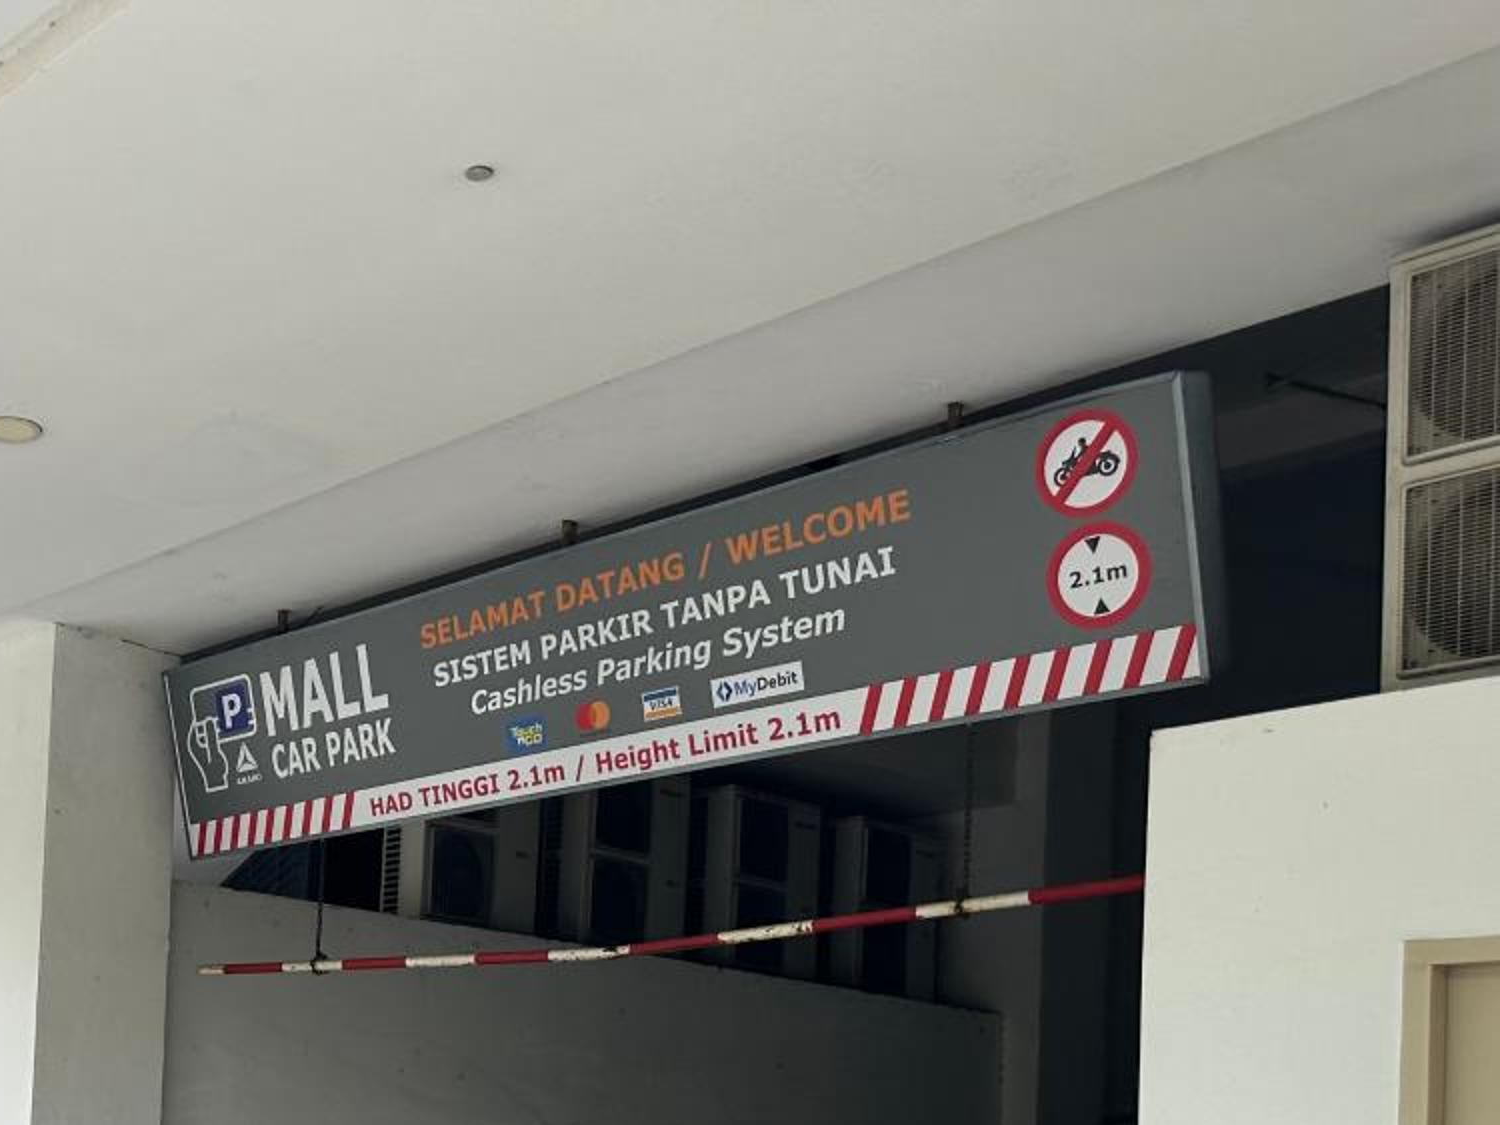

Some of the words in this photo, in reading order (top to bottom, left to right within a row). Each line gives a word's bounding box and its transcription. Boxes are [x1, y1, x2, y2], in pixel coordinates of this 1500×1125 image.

[420, 590, 546, 649] SELAMAT
[555, 552, 685, 612] DATANG
[699, 543, 715, 579] /
[725, 490, 912, 565] WELCOME
[1069, 564, 1128, 589] 2.1m
[434, 637, 531, 687] SISTEM
[540, 609, 653, 661] PARKIR
[660, 579, 771, 629] TANPA
[779, 547, 896, 600] TUNAI
[260, 643, 389, 736] MALL
[471, 668, 587, 716] Cashless
[597, 638, 712, 685] Parking
[723, 608, 847, 660] System
[733, 671, 798, 696] MyDebit
[221, 693, 241, 728] P
[649, 698, 674, 711] VISA
[272, 737, 321, 778] CAR
[326, 717, 396, 767] PARK
[370, 793, 414, 818] HAD
[418, 773, 499, 809] TINGGI
[507, 763, 565, 790] 2.1m
[575, 755, 585, 782] /
[595, 738, 681, 774] Height
[688, 721, 759, 757] Limit
[768, 707, 841, 742] 2.1m
